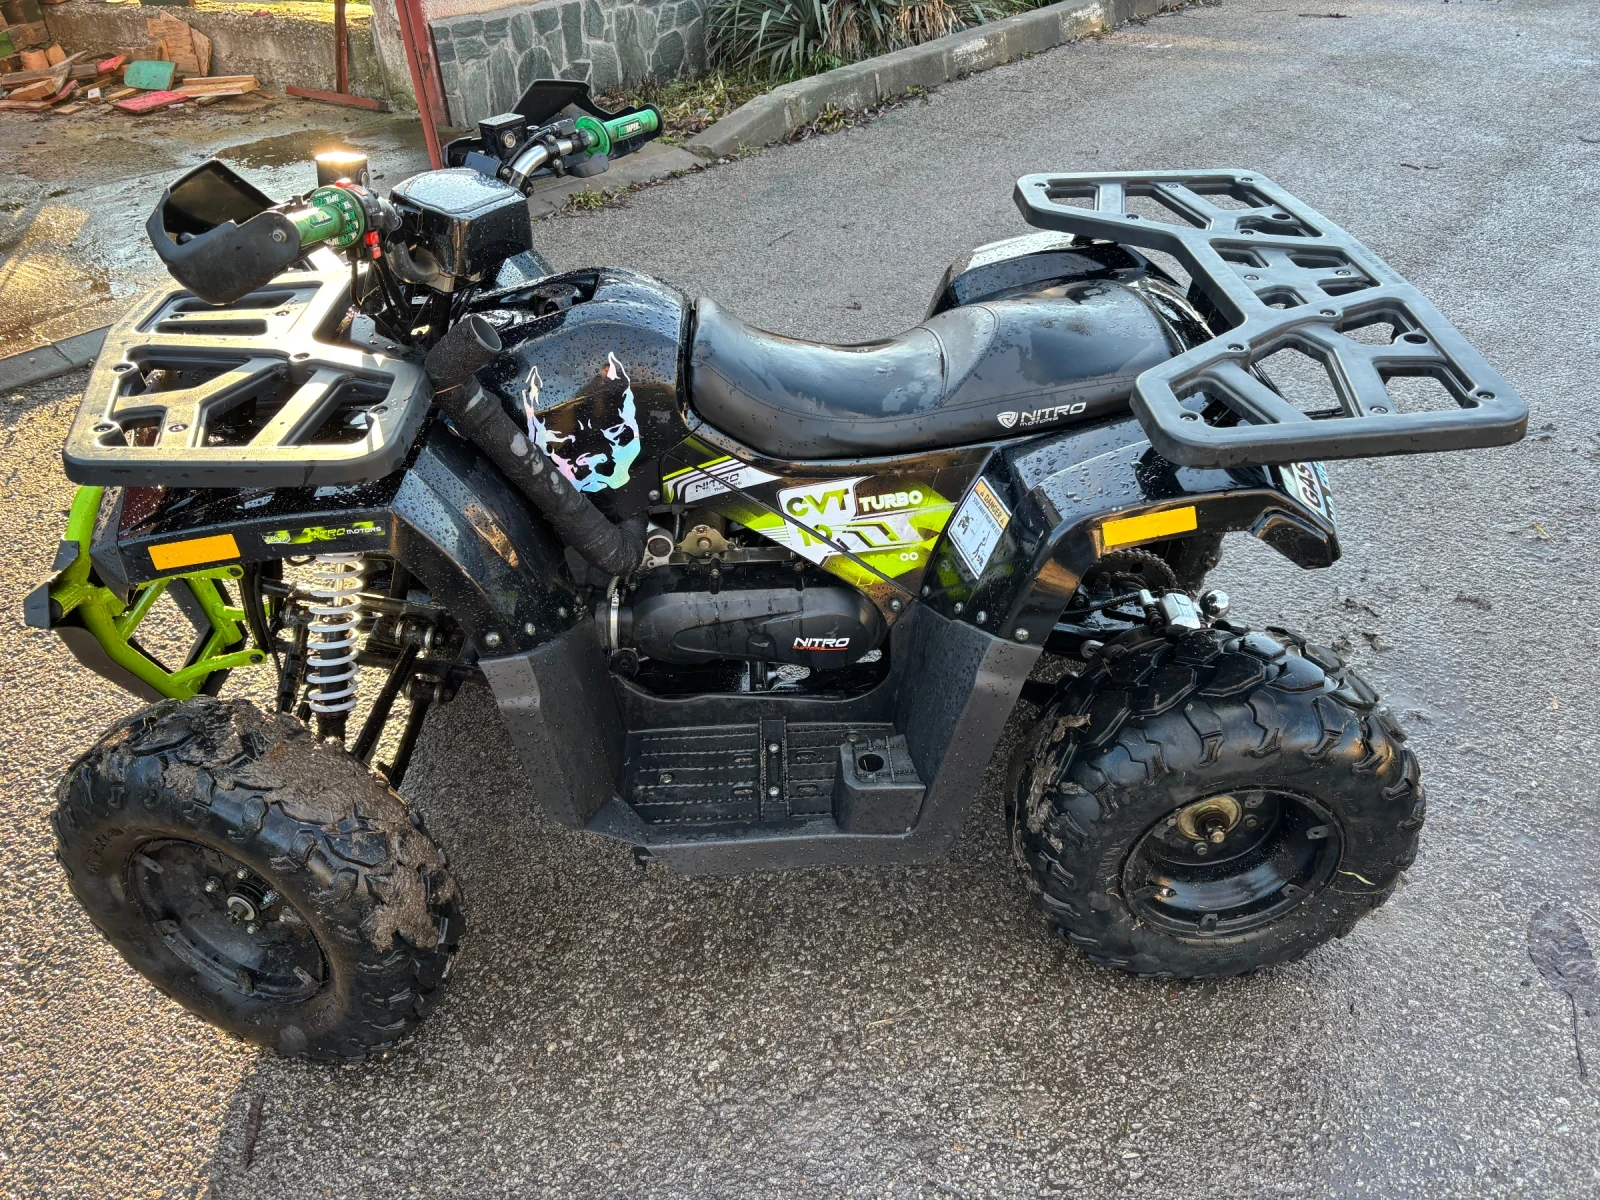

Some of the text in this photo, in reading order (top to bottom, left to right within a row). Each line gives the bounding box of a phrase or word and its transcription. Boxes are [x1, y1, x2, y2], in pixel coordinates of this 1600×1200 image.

[1020, 402, 1086, 423] NITRO
[1019, 416, 1059, 427] MOTORS
[786, 488, 924, 517] CVT TURBO
[982, 493, 1003, 519] DANGER
[346, 526, 382, 535] MOTORS
[793, 637, 850, 648] NITRO
